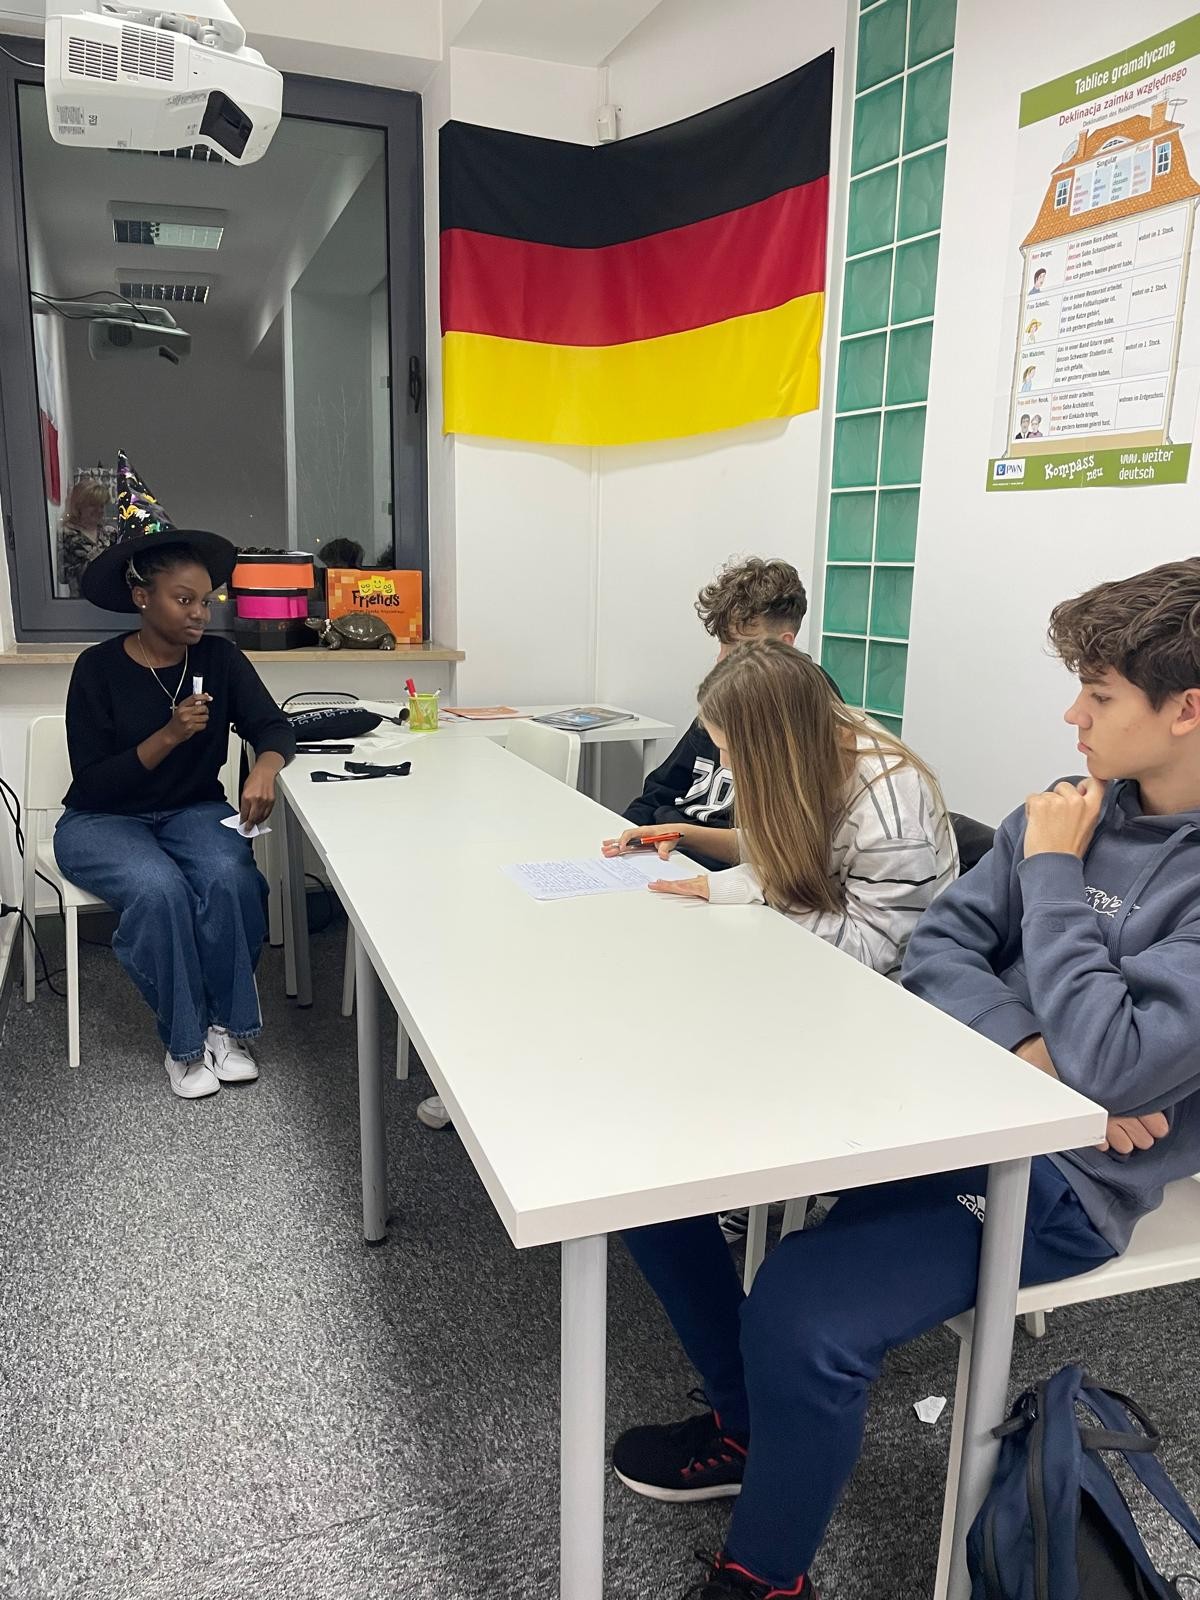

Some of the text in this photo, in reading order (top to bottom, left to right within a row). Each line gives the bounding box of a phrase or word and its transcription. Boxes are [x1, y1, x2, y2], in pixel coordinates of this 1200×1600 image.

[1076, 40, 1176, 94] Tablice gramatyczne
[1059, 68, 1187, 126] Deklinacja zaimka względnego
[1120, 448, 1174, 464] www.weiter
[1006, 463, 1023, 474] PWN
[1044, 454, 1095, 480] Kompass
[1086, 467, 1103, 481] neu
[1119, 466, 1154, 480] deutsch
[352, 590, 400, 608] Friends
[957, 1194, 985, 1223] adid
